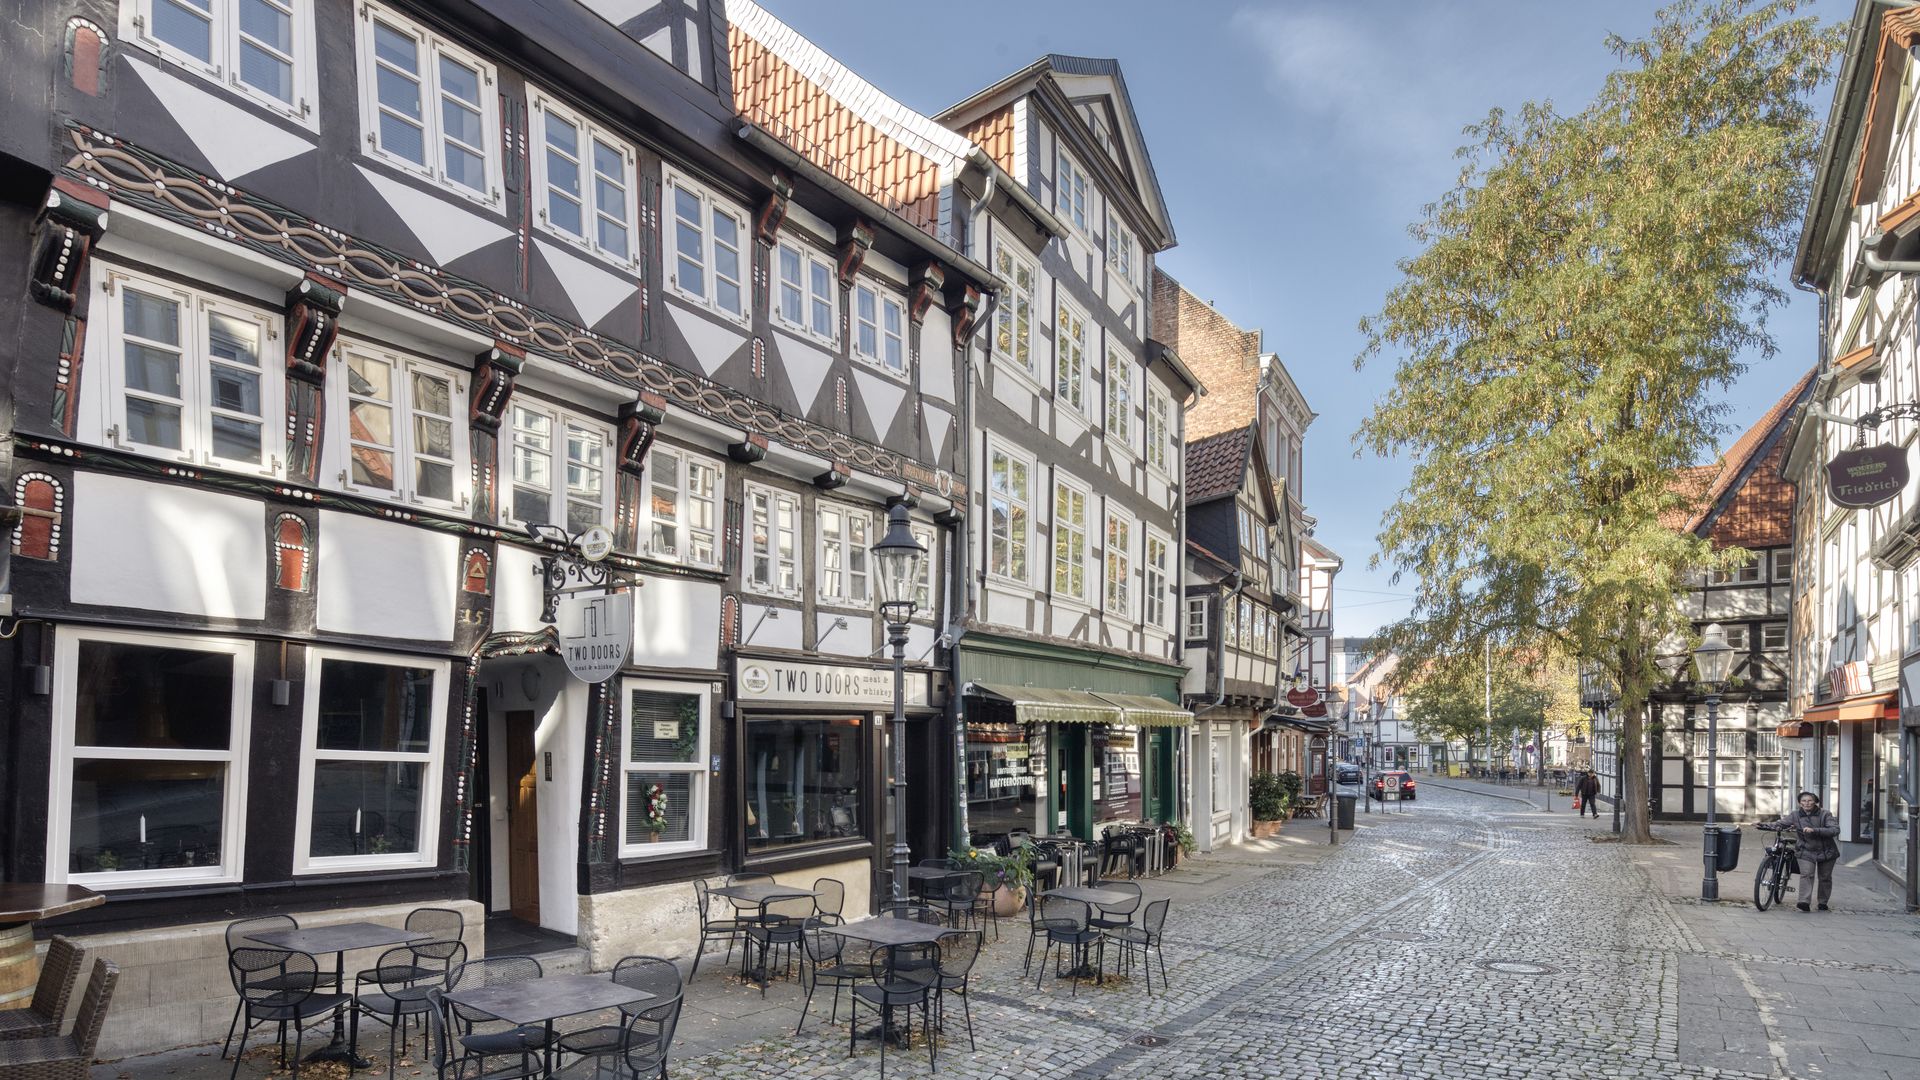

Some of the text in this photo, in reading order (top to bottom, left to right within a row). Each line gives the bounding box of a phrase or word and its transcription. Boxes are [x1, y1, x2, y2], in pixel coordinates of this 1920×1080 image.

[569, 644, 621, 661] TWO DOORS
[775, 669, 807, 693] TWO
[815, 672, 860, 695] DOORS
[863, 675, 881, 683] meat
[863, 688, 892, 698] whiskey
